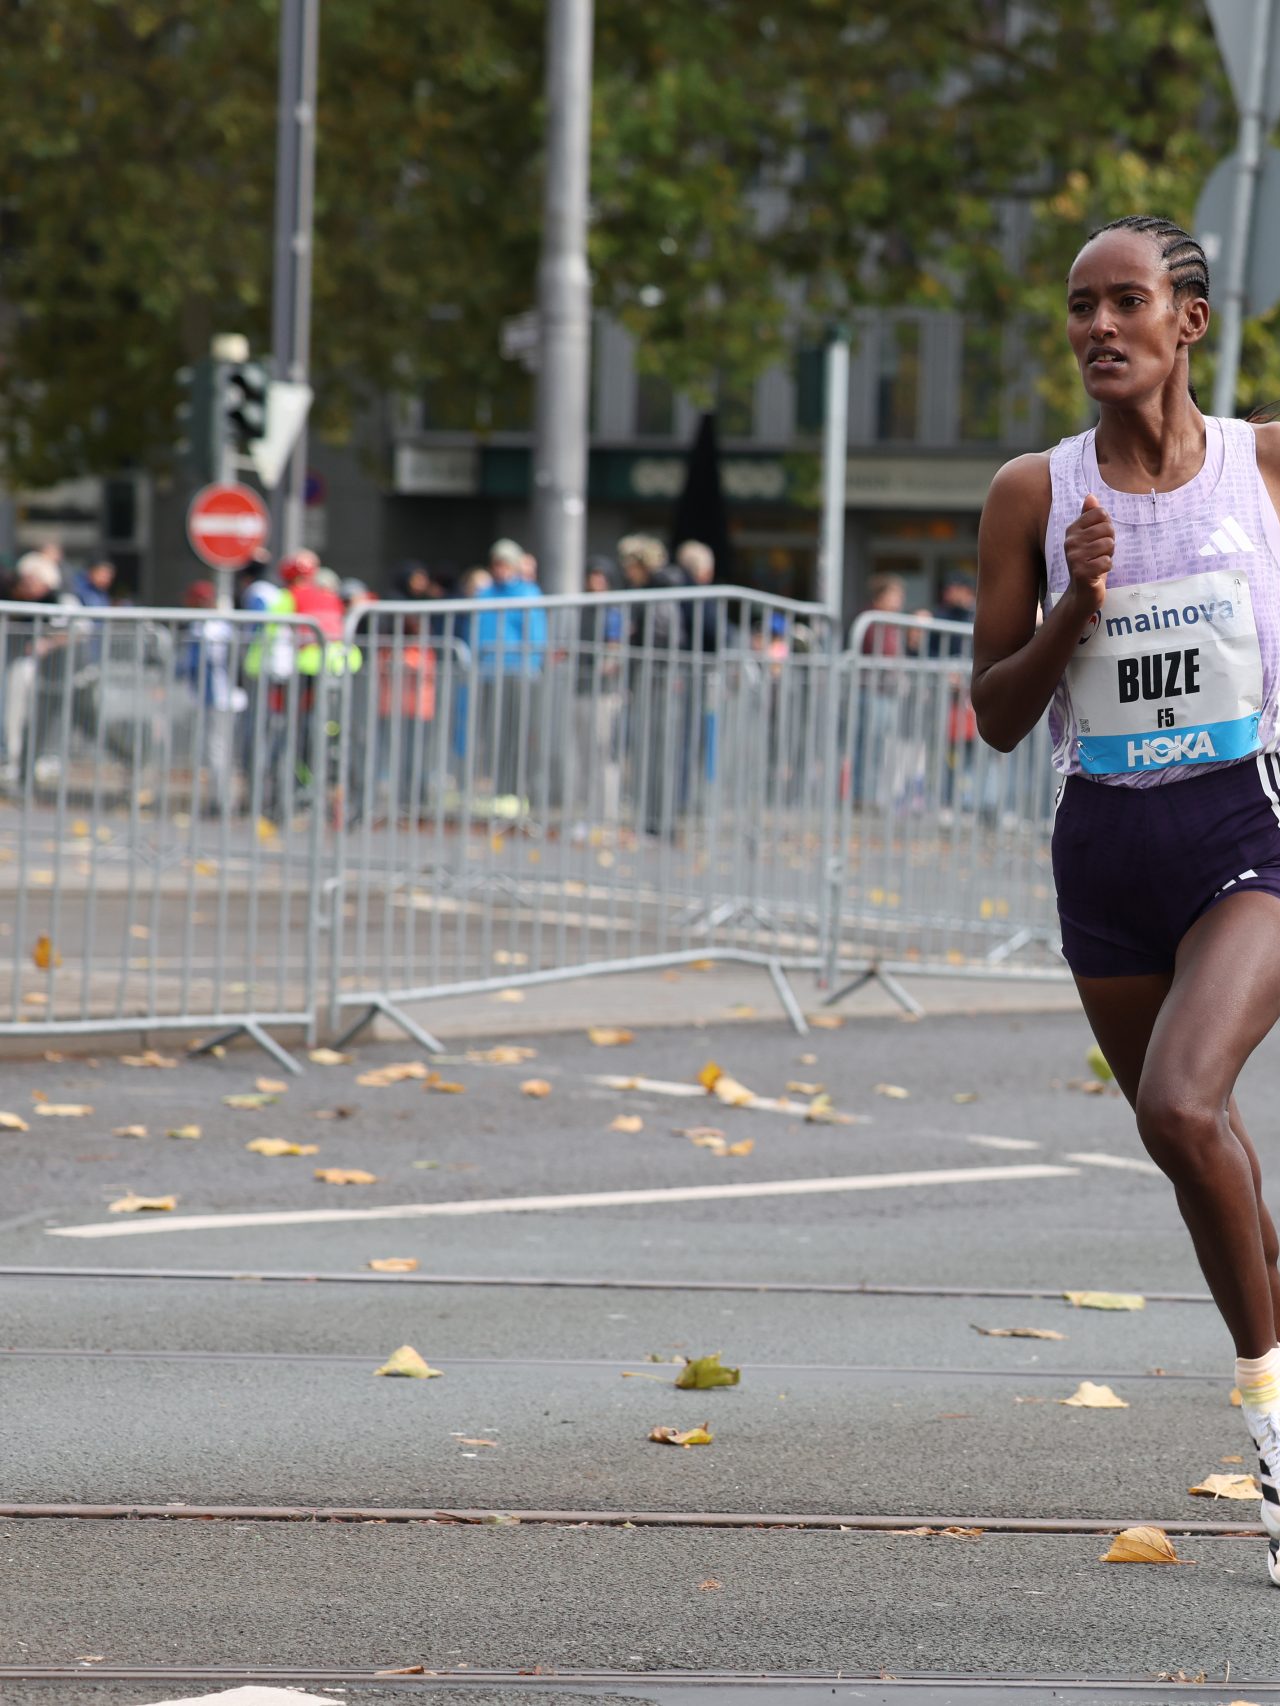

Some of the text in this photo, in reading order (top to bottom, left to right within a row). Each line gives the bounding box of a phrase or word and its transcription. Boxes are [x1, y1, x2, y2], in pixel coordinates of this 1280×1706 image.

[1106, 599, 1234, 637] mainova
[1117, 648, 1200, 703] BUZE
[1157, 707, 1175, 729] F5
[1127, 730, 1216, 768] HOKA
